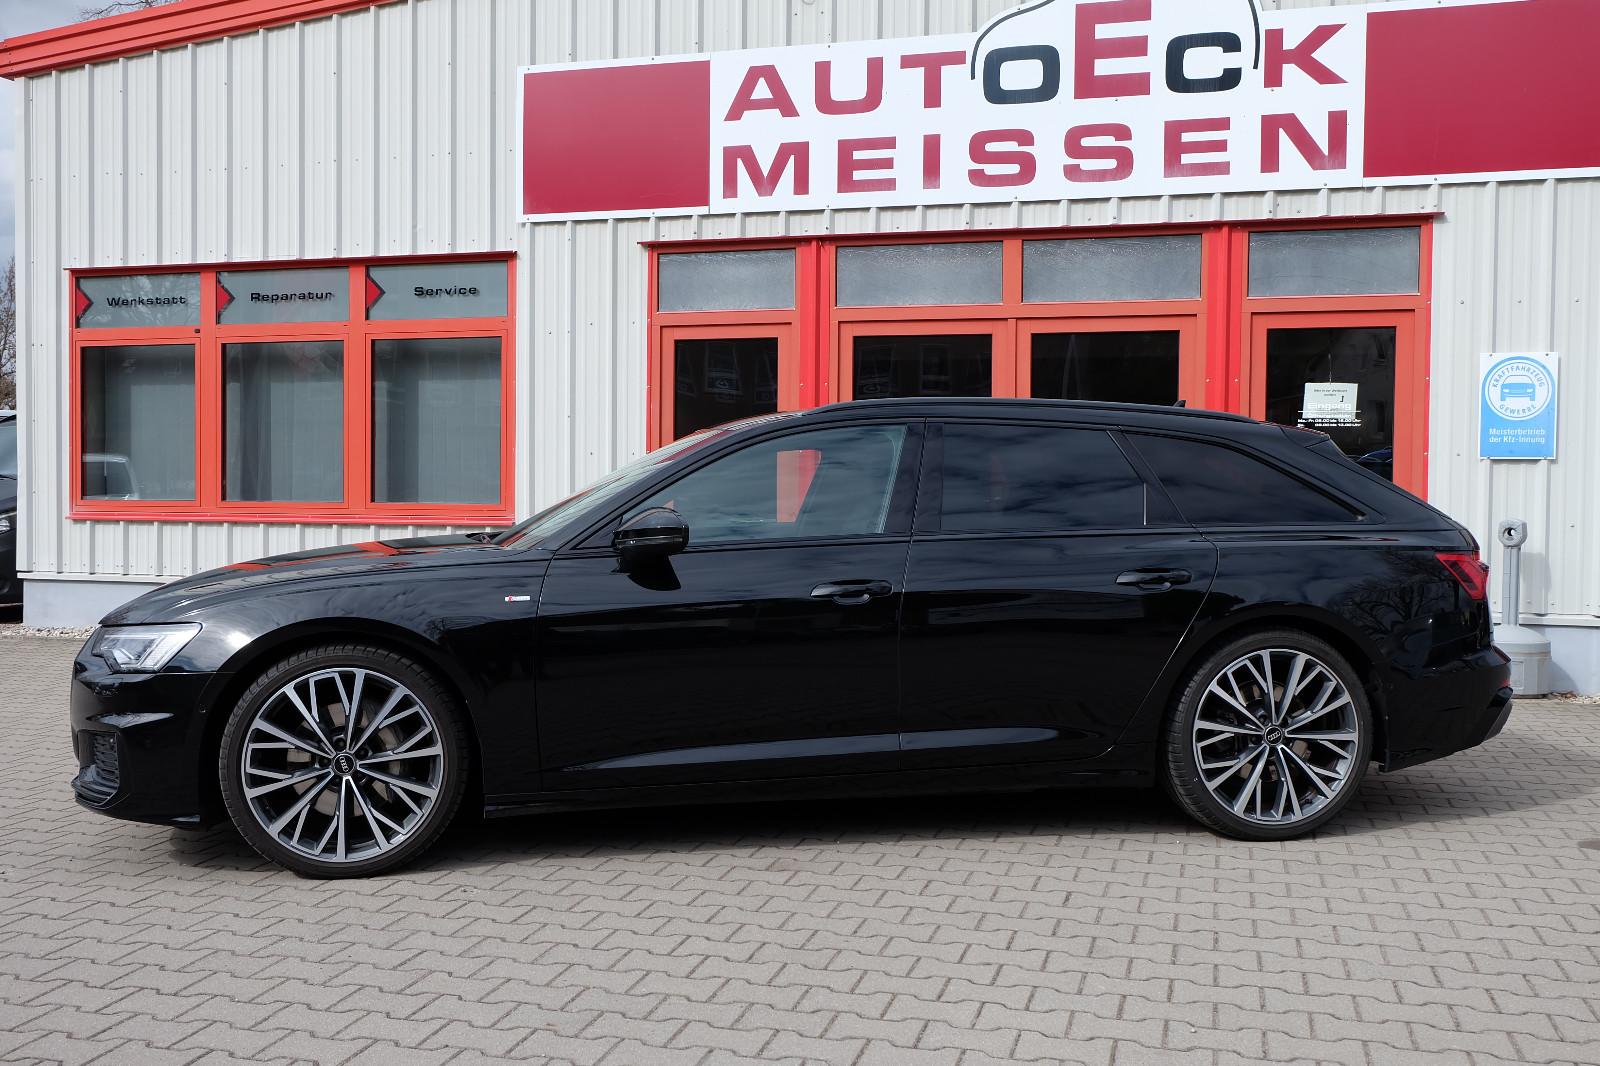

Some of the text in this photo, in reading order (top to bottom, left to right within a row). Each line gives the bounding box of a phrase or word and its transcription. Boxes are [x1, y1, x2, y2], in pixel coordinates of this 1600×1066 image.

[723, 0, 1348, 122] AUTOECK
[722, 110, 1348, 199] MEISSEN
[250, 291, 333, 304] Reparatur
[414, 285, 478, 297] Service
[106, 295, 186, 308] Werkstatt
[1492, 365, 1545, 388] KRAFTFAHRZEUG
[1499, 403, 1537, 416] GEWERBE
[1503, 435, 1545, 445] Kfz-Innung
